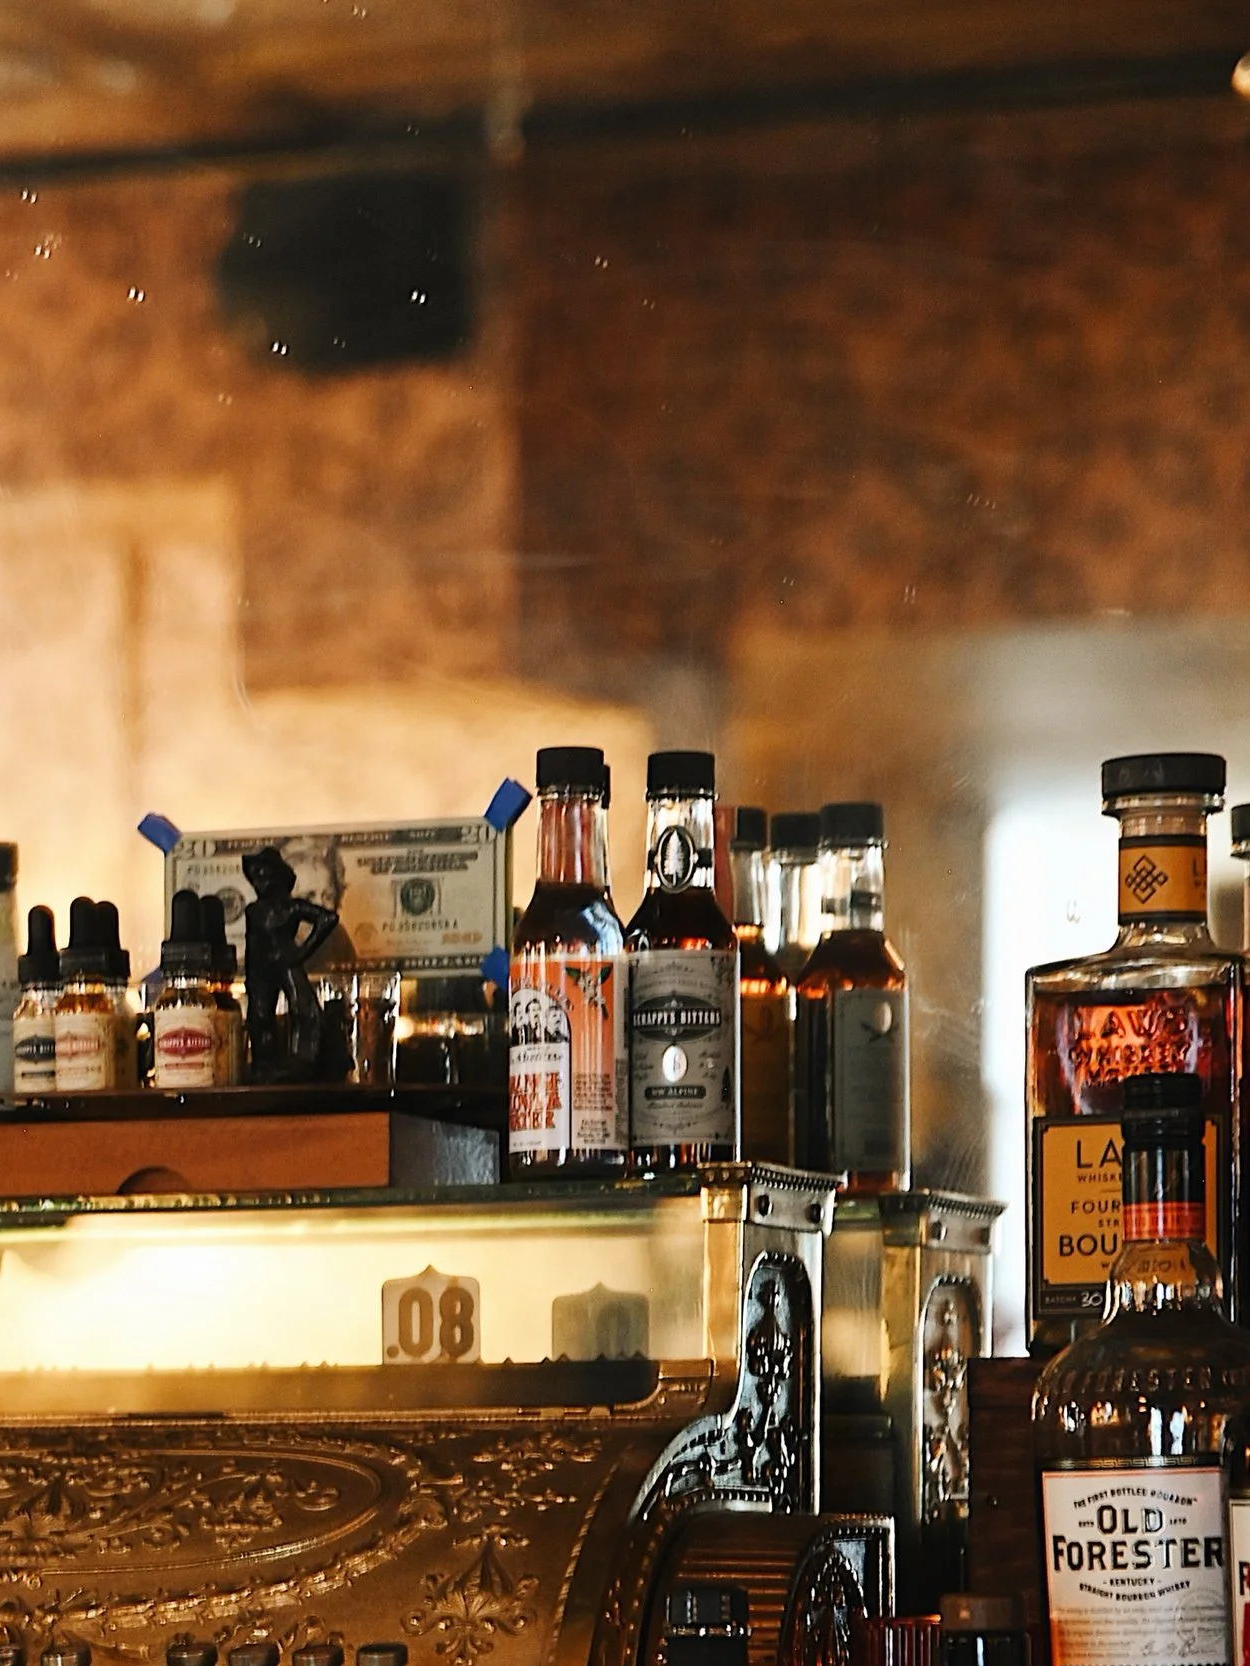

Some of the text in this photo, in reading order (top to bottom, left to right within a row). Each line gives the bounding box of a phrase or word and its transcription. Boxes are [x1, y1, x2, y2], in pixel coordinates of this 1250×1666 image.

[1076, 1138, 1122, 1169] LA
[1071, 1200, 1121, 1215] FOUR
[1096, 1504, 1165, 1535] OLD
[1052, 1534, 1224, 1572] FORESTER
